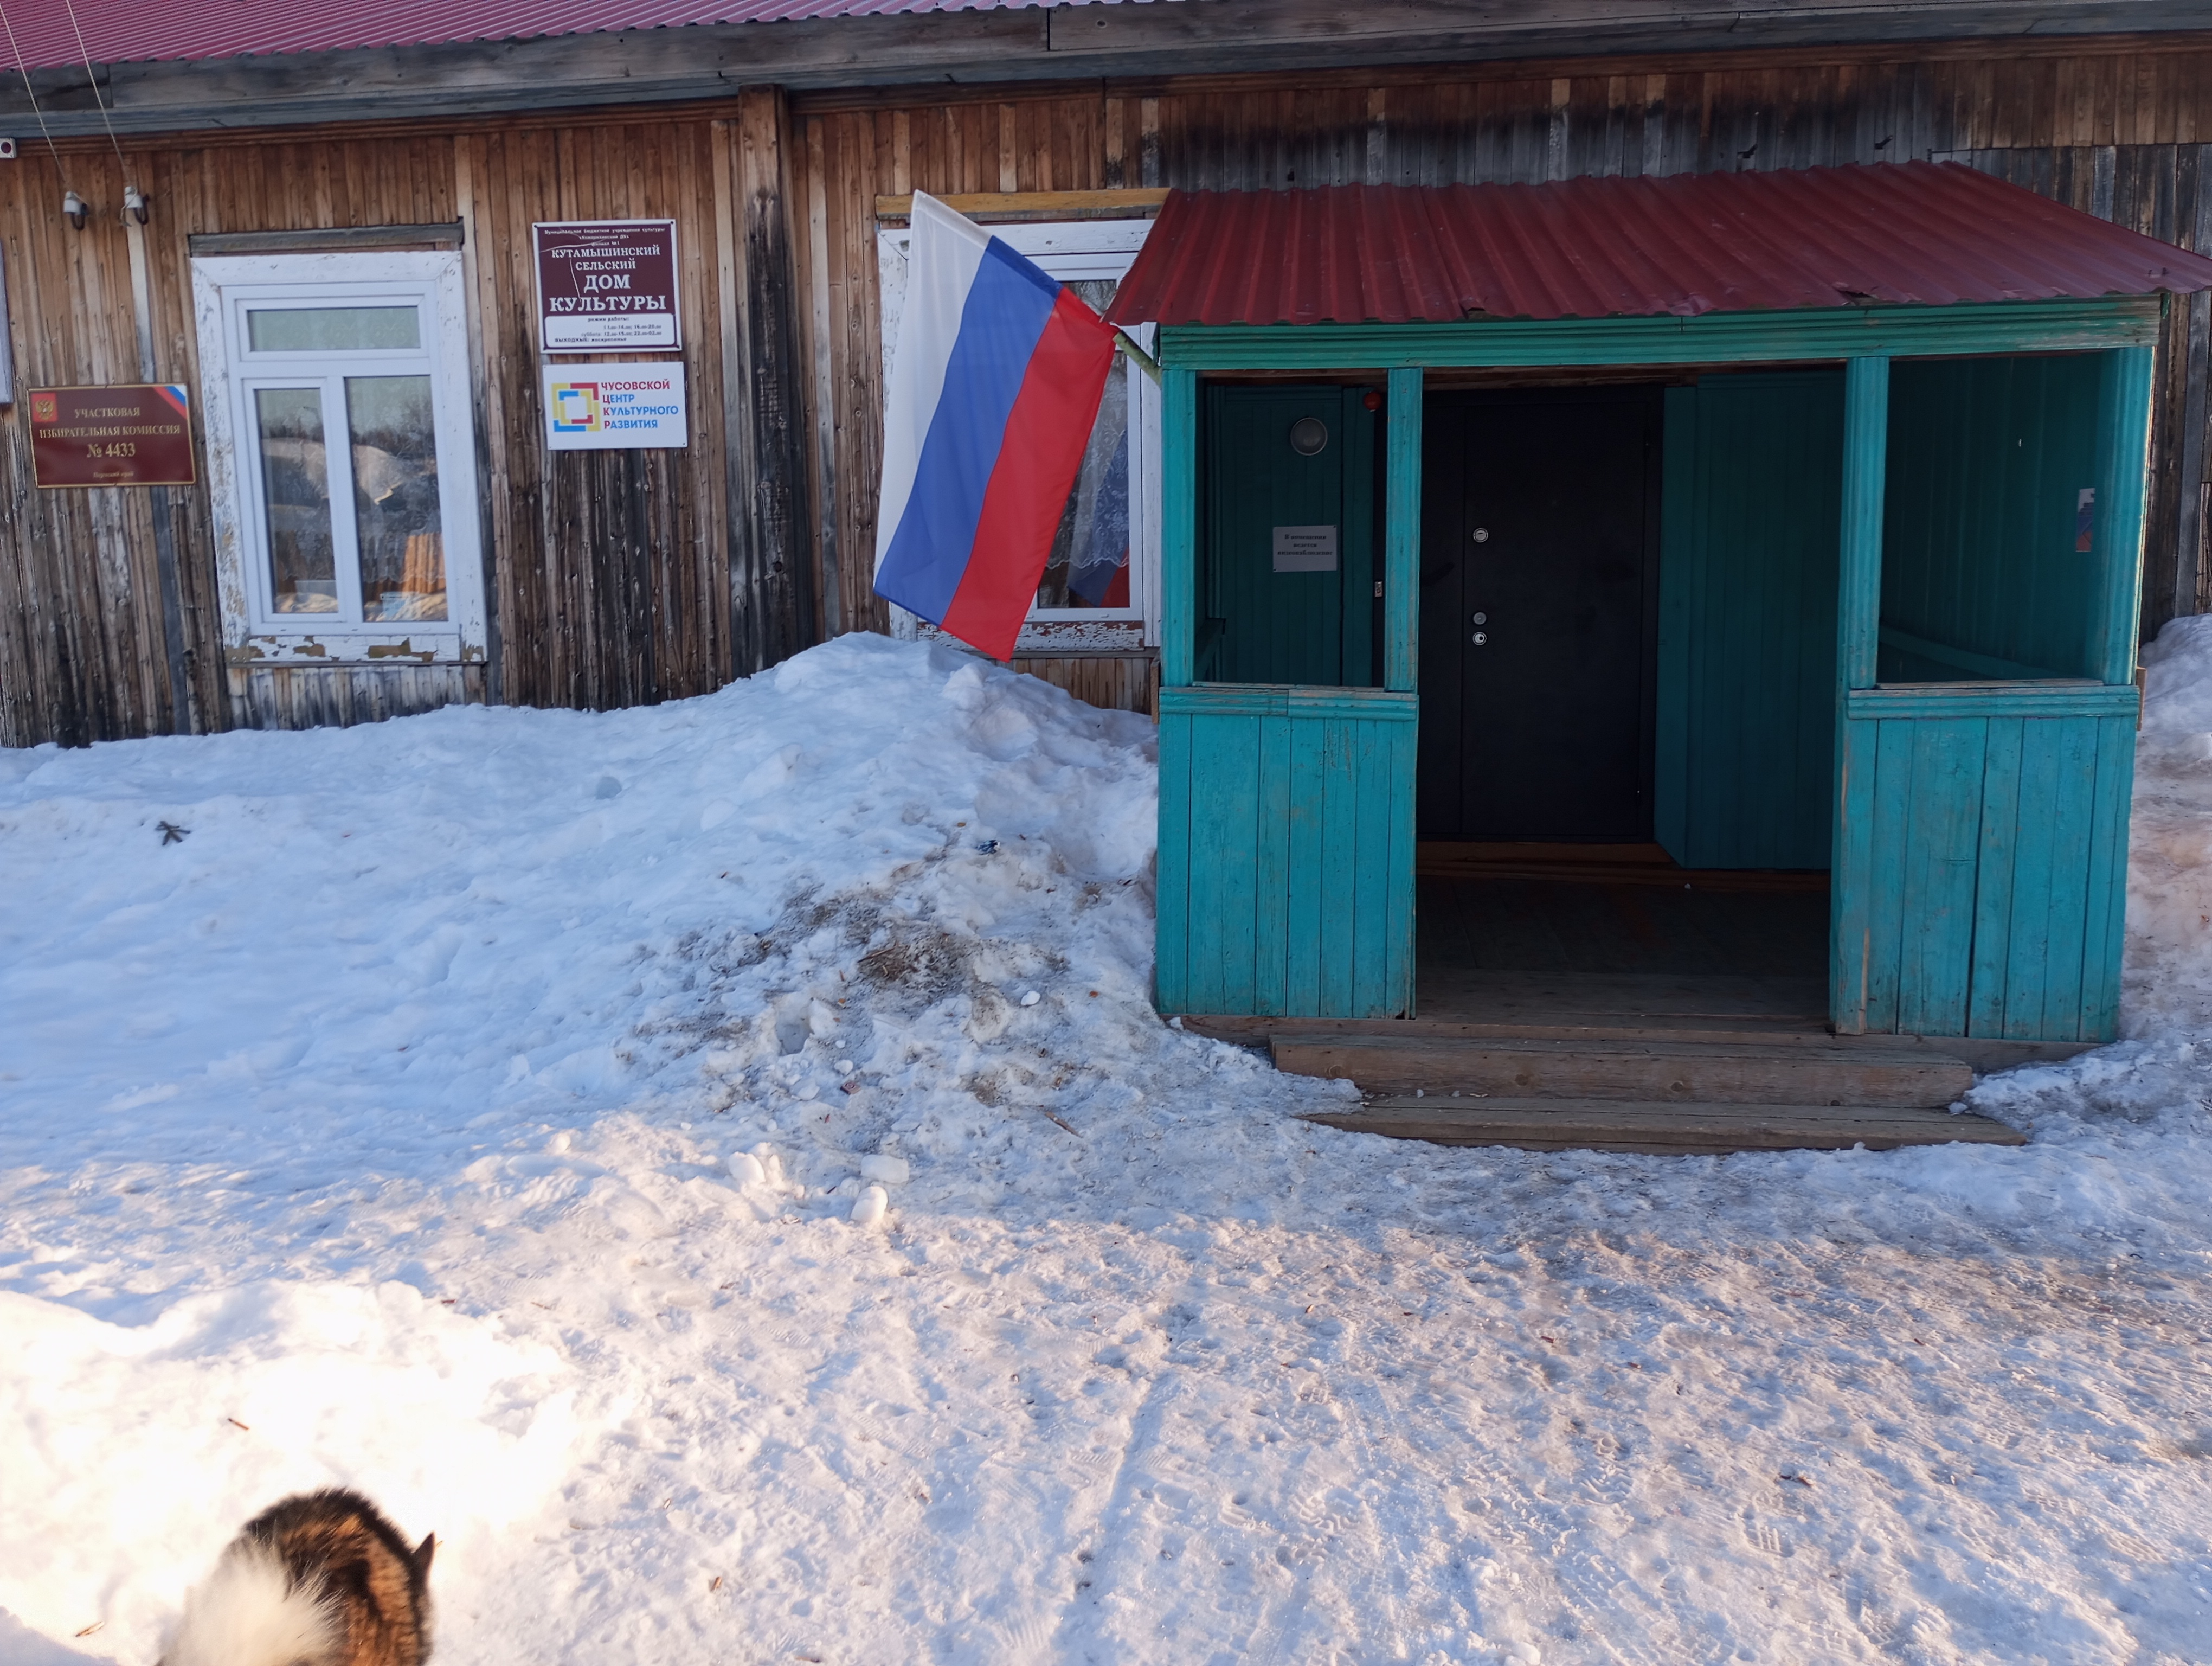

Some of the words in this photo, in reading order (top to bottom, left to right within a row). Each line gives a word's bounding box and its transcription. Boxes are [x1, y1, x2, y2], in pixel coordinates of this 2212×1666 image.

[551, 244, 661, 258] КУТАМЫШИНСКИЙ
[575, 258, 636, 271] СЕЛЬСКИЙ
[583, 274, 631, 293] ДОМ
[549, 295, 667, 312] КУЛЬТУРЫ
[601, 379, 670, 391] ЧУСОВСКОЙ
[602, 394, 635, 405] ЦЕНТР
[74, 407, 141, 419] УЧАСТКОВАЯ
[603, 405, 679, 416] КУЛЬТУРНОГО
[39, 426, 120, 438] ИЗБИРАТЕЛЬНАЯ
[122, 424, 181, 435] КОМИССИЯ
[604, 419, 658, 430] РАЗВИТИЯ
[87, 444, 102, 458] №
[105, 443, 136, 457] 4433
